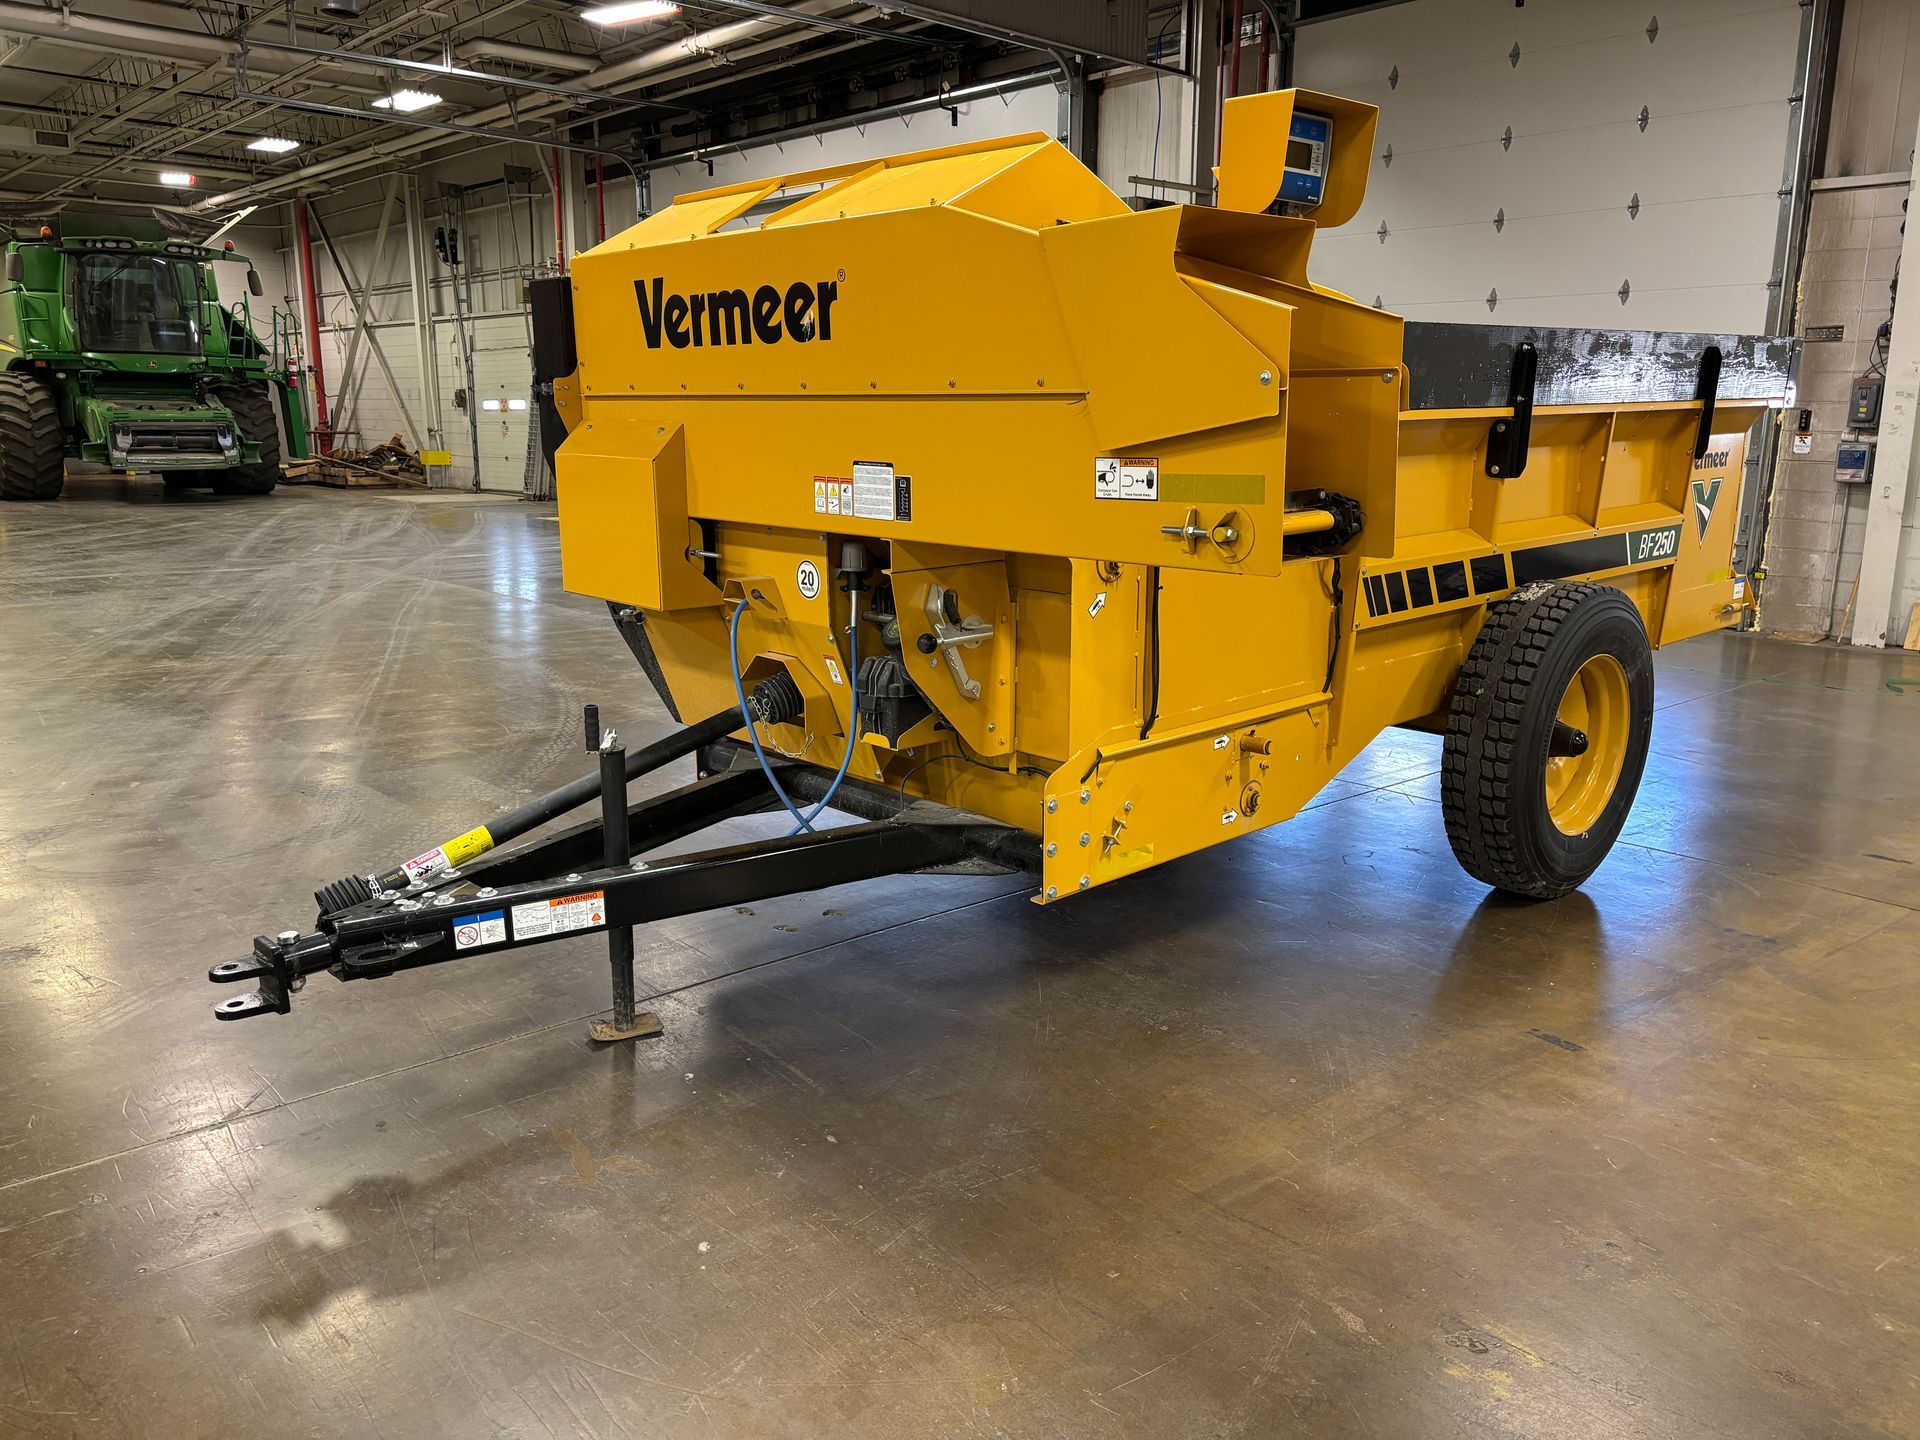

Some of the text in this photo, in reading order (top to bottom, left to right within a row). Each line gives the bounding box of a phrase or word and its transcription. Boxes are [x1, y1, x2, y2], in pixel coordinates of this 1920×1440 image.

[634, 276, 838, 349] Vermeer
[1694, 451, 1729, 470] ermeer
[1638, 529, 1676, 559] BF250
[800, 569, 814, 587] 20
[416, 850, 440, 864] DANGER
[563, 892, 598, 904] WARNING
